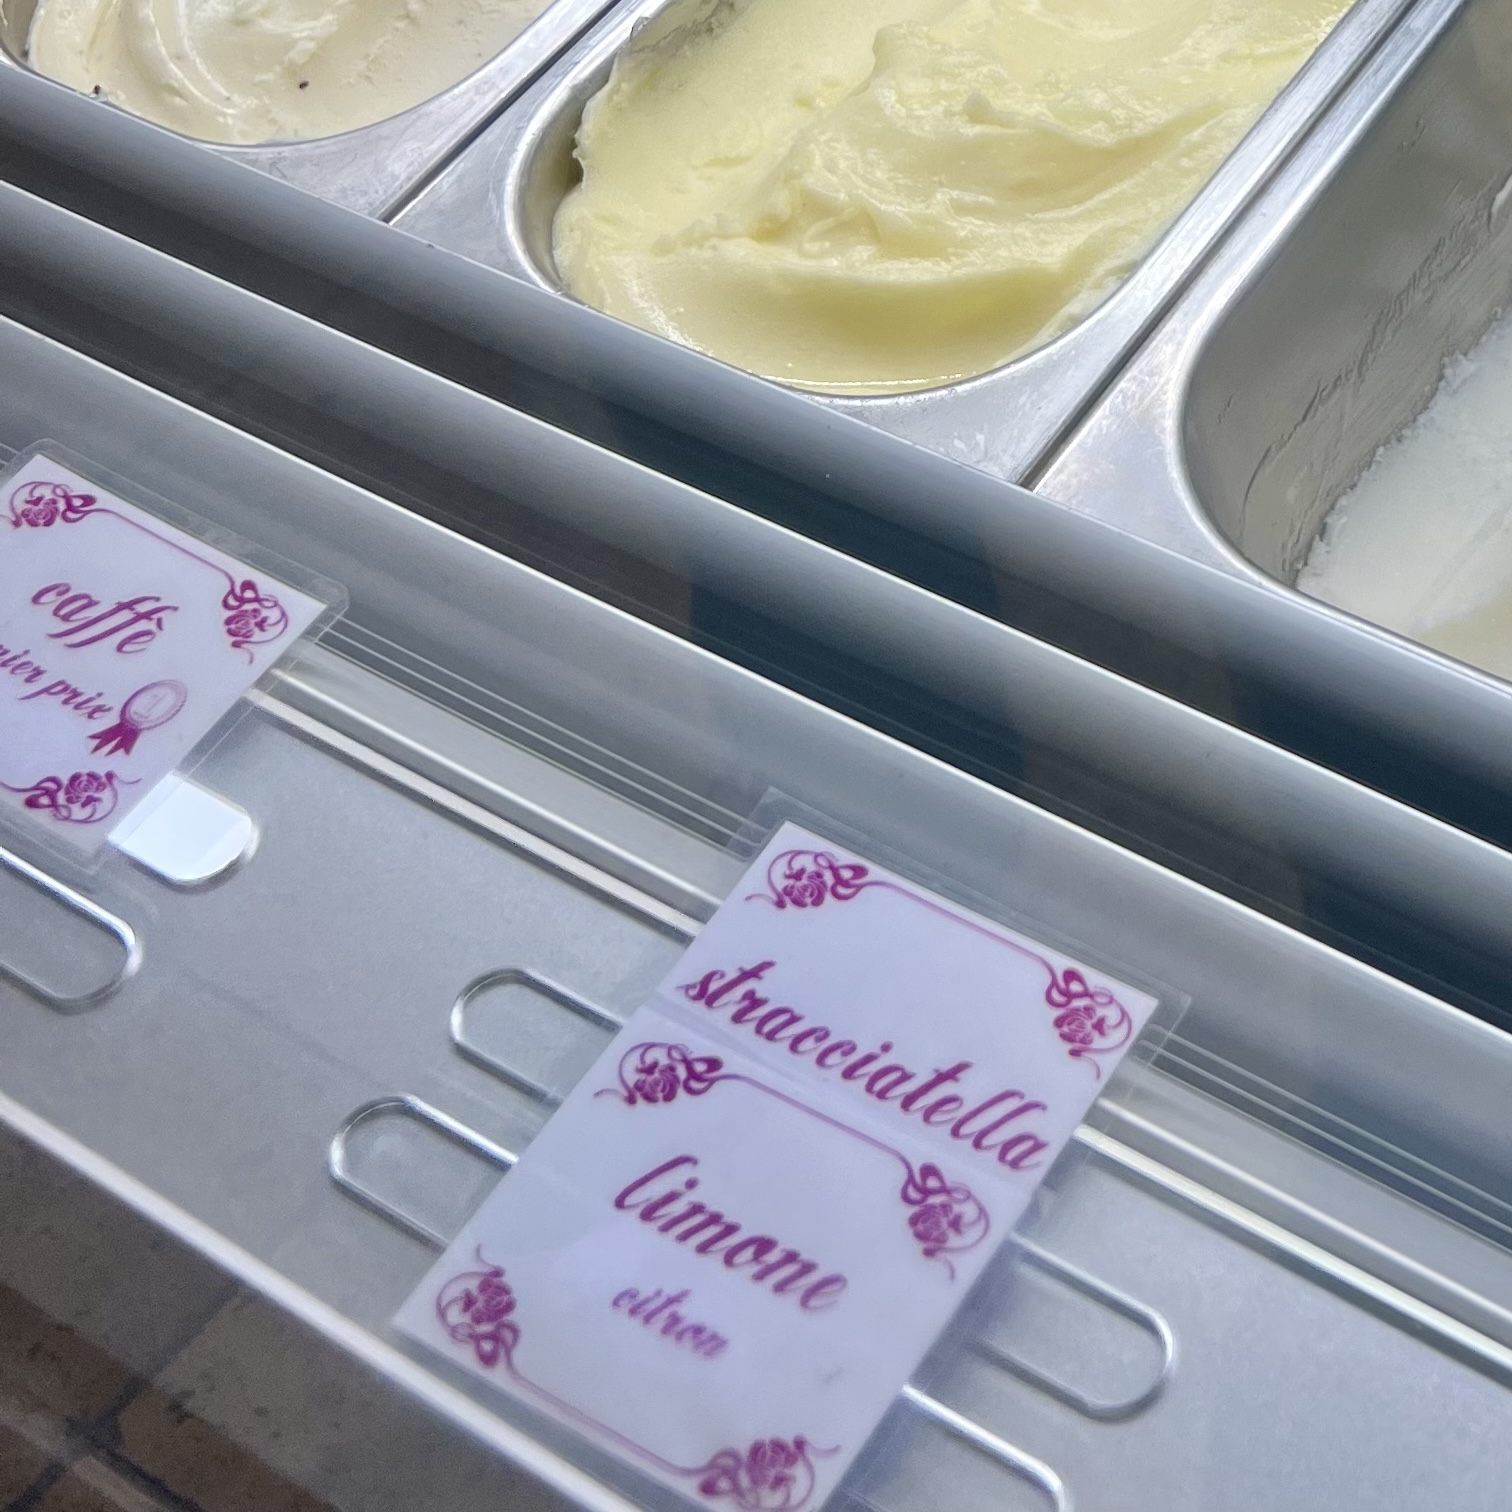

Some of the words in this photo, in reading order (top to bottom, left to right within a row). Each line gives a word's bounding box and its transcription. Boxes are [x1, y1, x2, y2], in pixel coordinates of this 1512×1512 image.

[32, 582, 179, 654] caffè
[18, 679, 114, 720] prix
[676, 960, 1049, 1170] stracciatella
[614, 1154, 848, 1311] limone
[611, 1287, 729, 1357] citron
